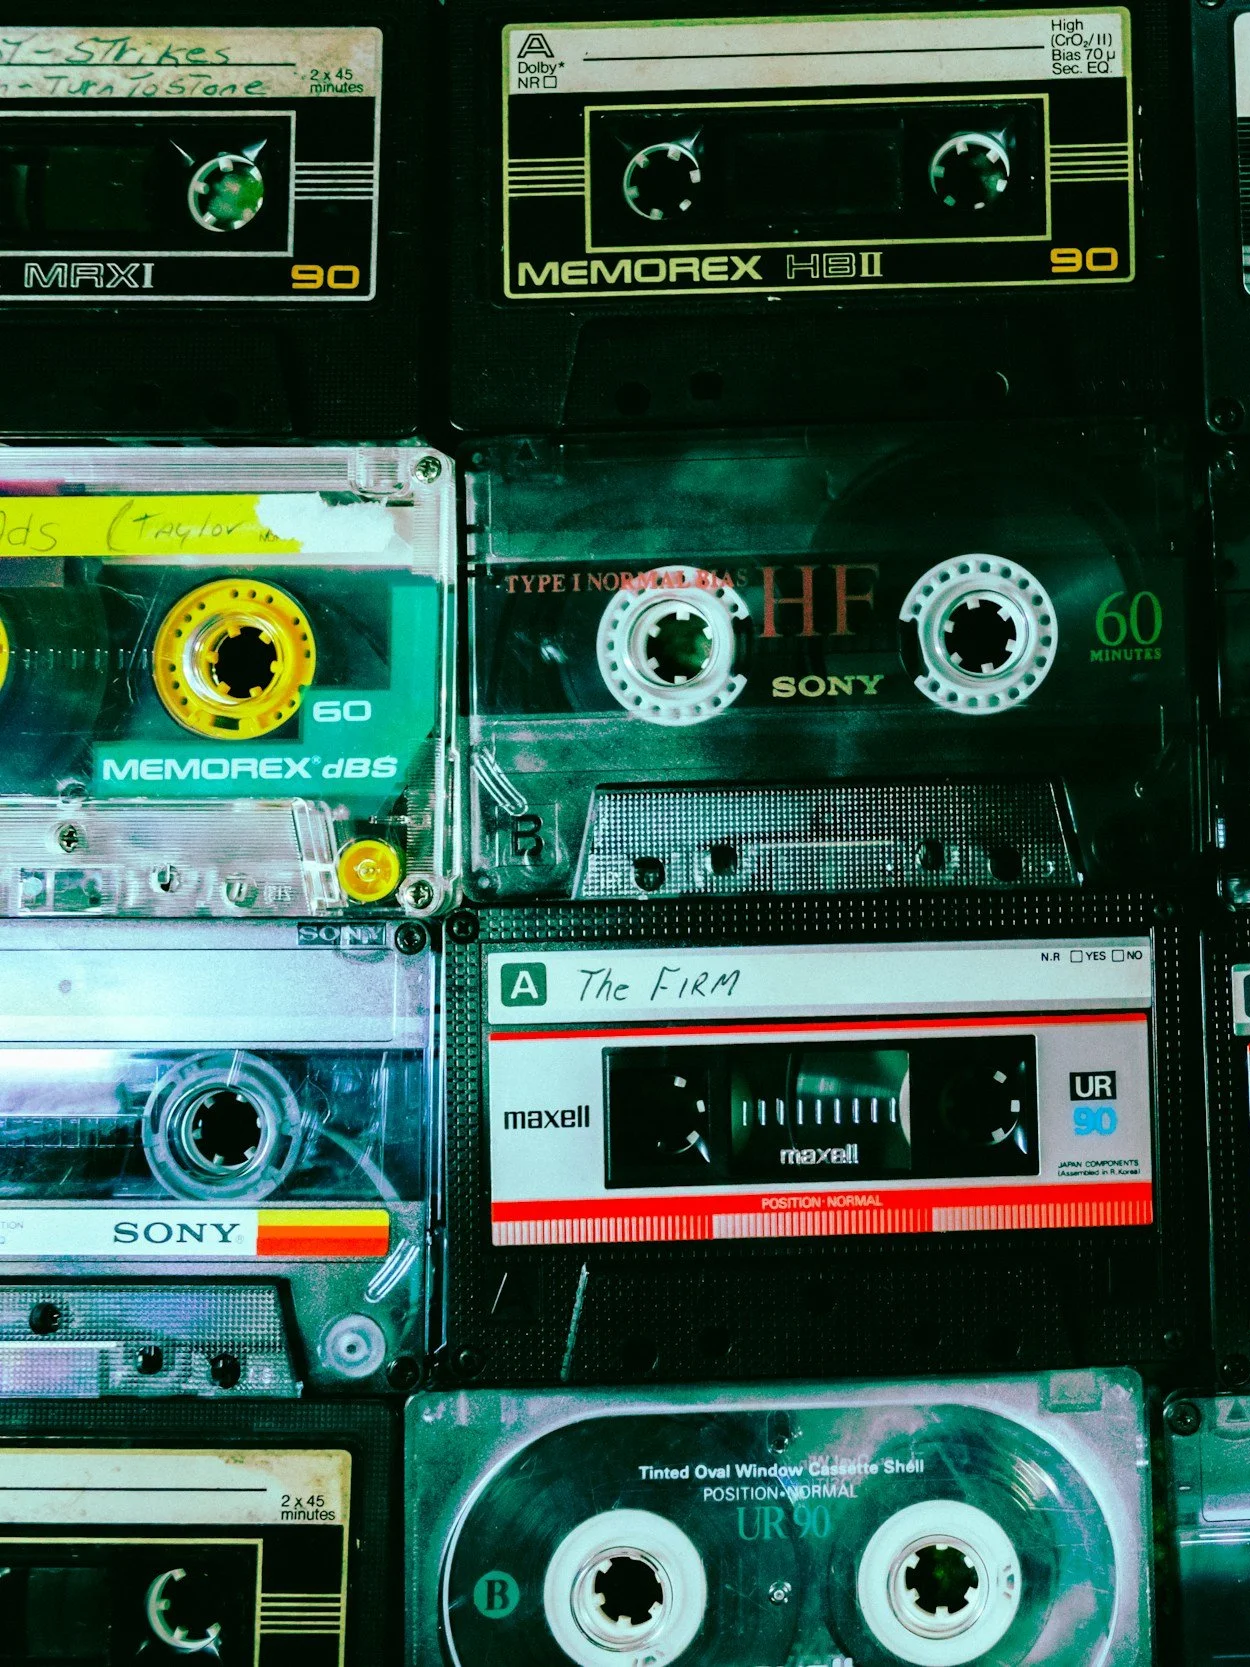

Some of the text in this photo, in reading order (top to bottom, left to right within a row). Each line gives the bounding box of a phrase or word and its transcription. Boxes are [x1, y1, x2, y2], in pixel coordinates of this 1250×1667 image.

[1051, 18, 1084, 33] High
[517, 33, 555, 58] A
[1052, 49, 1081, 61] Bias
[1085, 48, 1104, 61] 70
[310, 68, 354, 81] 2 x 45
[1052, 61, 1114, 75] Sec. EQ.
[309, 81, 365, 94] minutes
[518, 76, 541, 89] NR
[290, 264, 360, 290] 90
[517, 254, 764, 287] MEMOREX
[1049, 246, 1119, 274] 90
[505, 574, 566, 595] TYPE
[588, 570, 695, 592] NORMAL
[696, 568, 748, 590] BIAS
[757, 562, 881, 639] HF
[1095, 591, 1163, 647] 60
[1089, 647, 1163, 663] MINUTES
[772, 673, 884, 699] SONY
[312, 699, 373, 723] 60
[1085, 950, 1107, 961] YES
[1126, 950, 1143, 960] NO
[511, 970, 539, 999] A
[577, 965, 741, 1002] The FIRM
[1075, 1075, 1112, 1098] UR
[504, 1106, 590, 1131] maxell
[1072, 1105, 1118, 1137] 90
[780, 1143, 859, 1165] maxell
[1058, 1159, 1139, 1169] JAPAN COMPONENTS
[639, 1465, 690, 1481] Tinted
[694, 1463, 731, 1480] Oval
[736, 1462, 804, 1479] Window
[808, 1460, 879, 1477] Cassette
[884, 1458, 925, 1474] Shell
[281, 1494, 325, 1507] 2 x 45
[281, 1508, 336, 1521] minutes
[736, 1505, 831, 1541] UR 90
